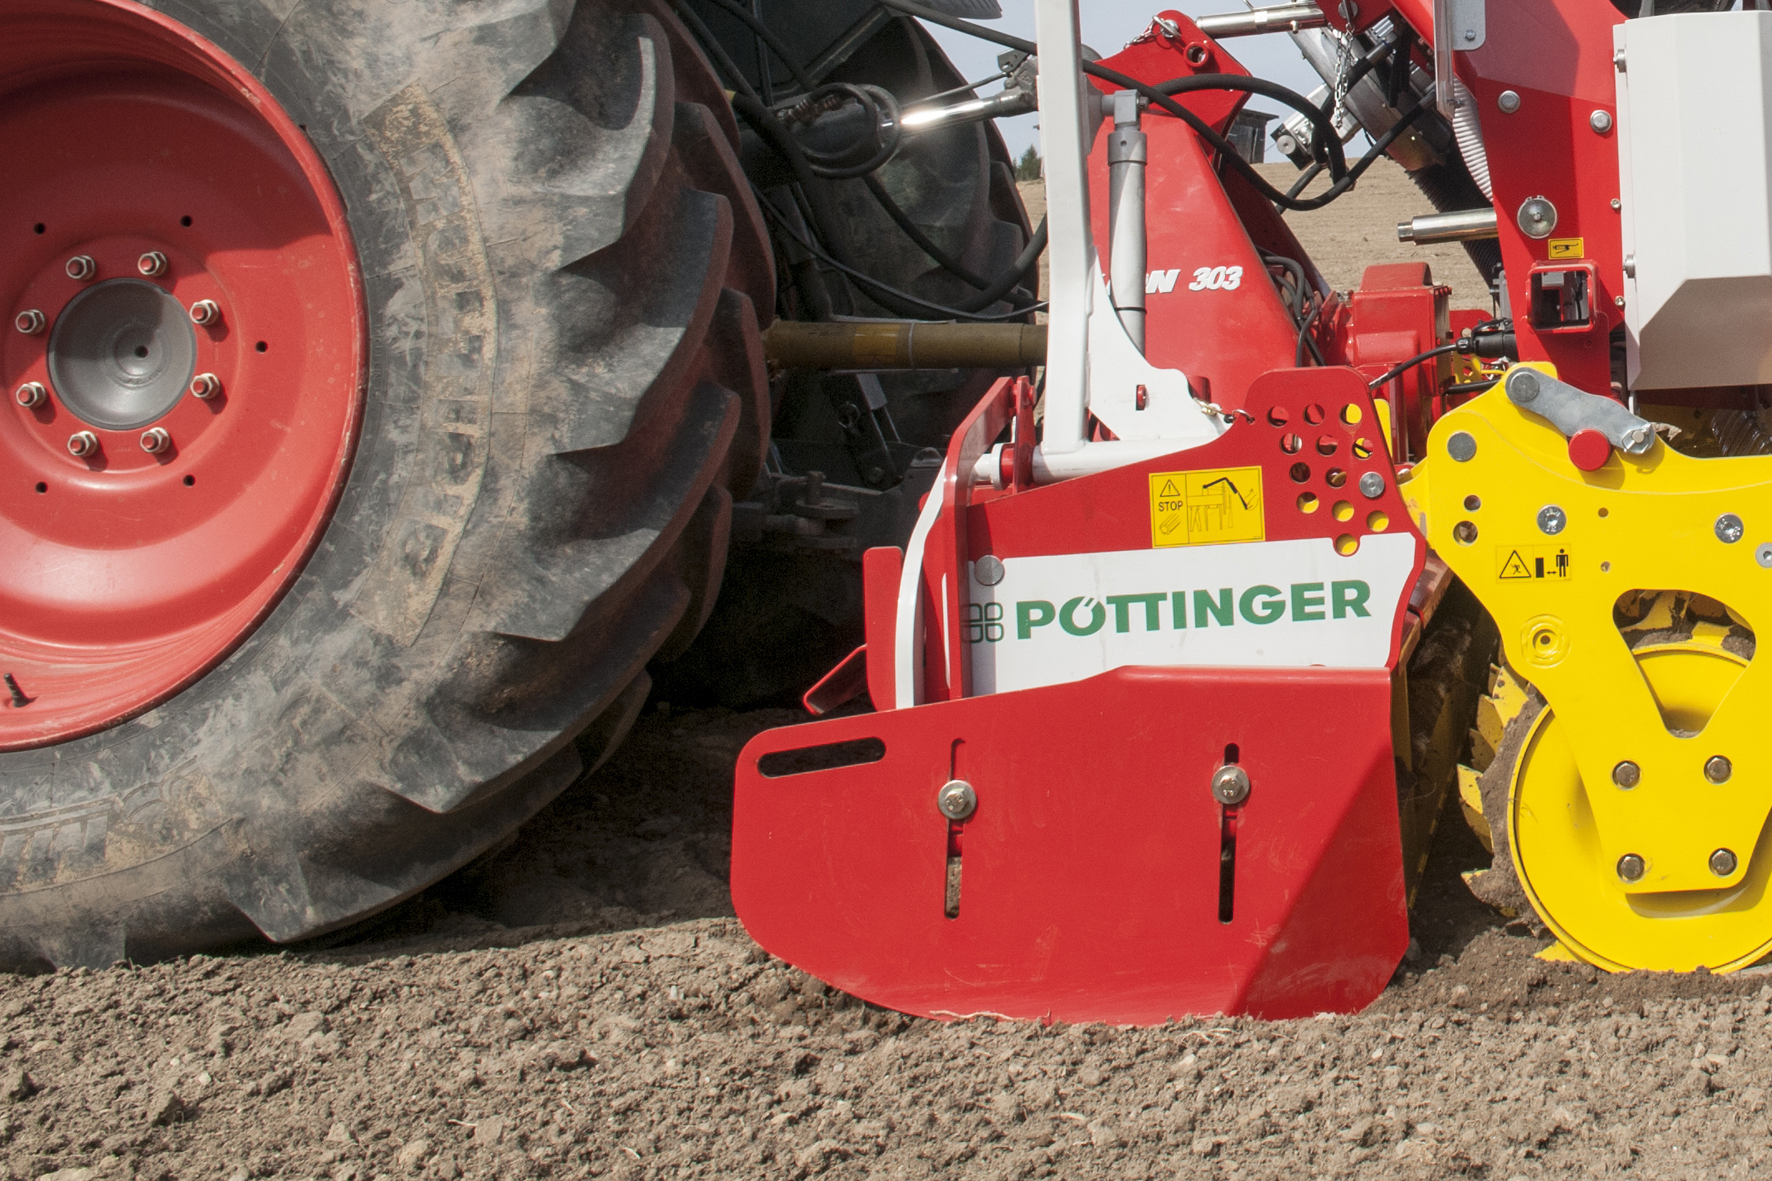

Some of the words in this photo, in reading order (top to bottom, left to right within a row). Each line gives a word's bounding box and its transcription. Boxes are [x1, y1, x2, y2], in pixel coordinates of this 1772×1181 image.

[1189, 266, 1243, 291] 303
[1158, 501, 1183, 512] STOP
[1016, 579, 1371, 639] PÖTTINGER
